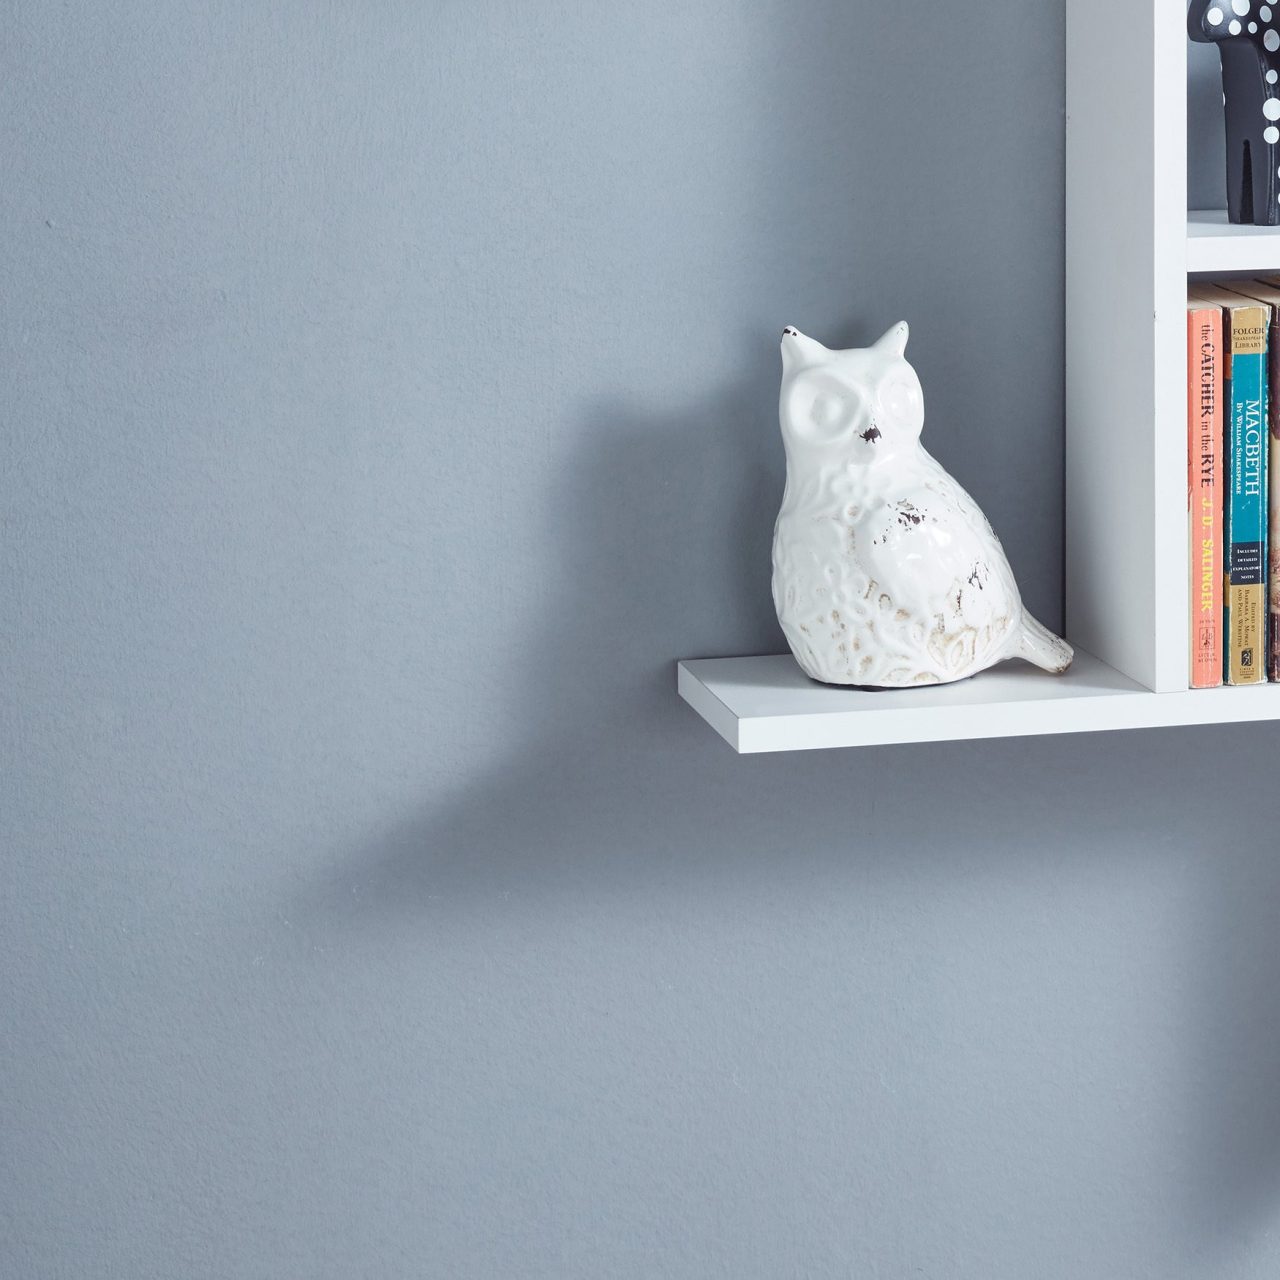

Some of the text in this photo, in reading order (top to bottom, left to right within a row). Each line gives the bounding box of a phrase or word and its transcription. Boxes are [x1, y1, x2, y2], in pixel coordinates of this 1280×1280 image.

[1233, 327, 1264, 335] FOLGER
[1200, 325, 1214, 488] the CATCHER in the RYE
[1245, 399, 1260, 496] MACBETH
[1201, 539, 1214, 612] SALINGER
